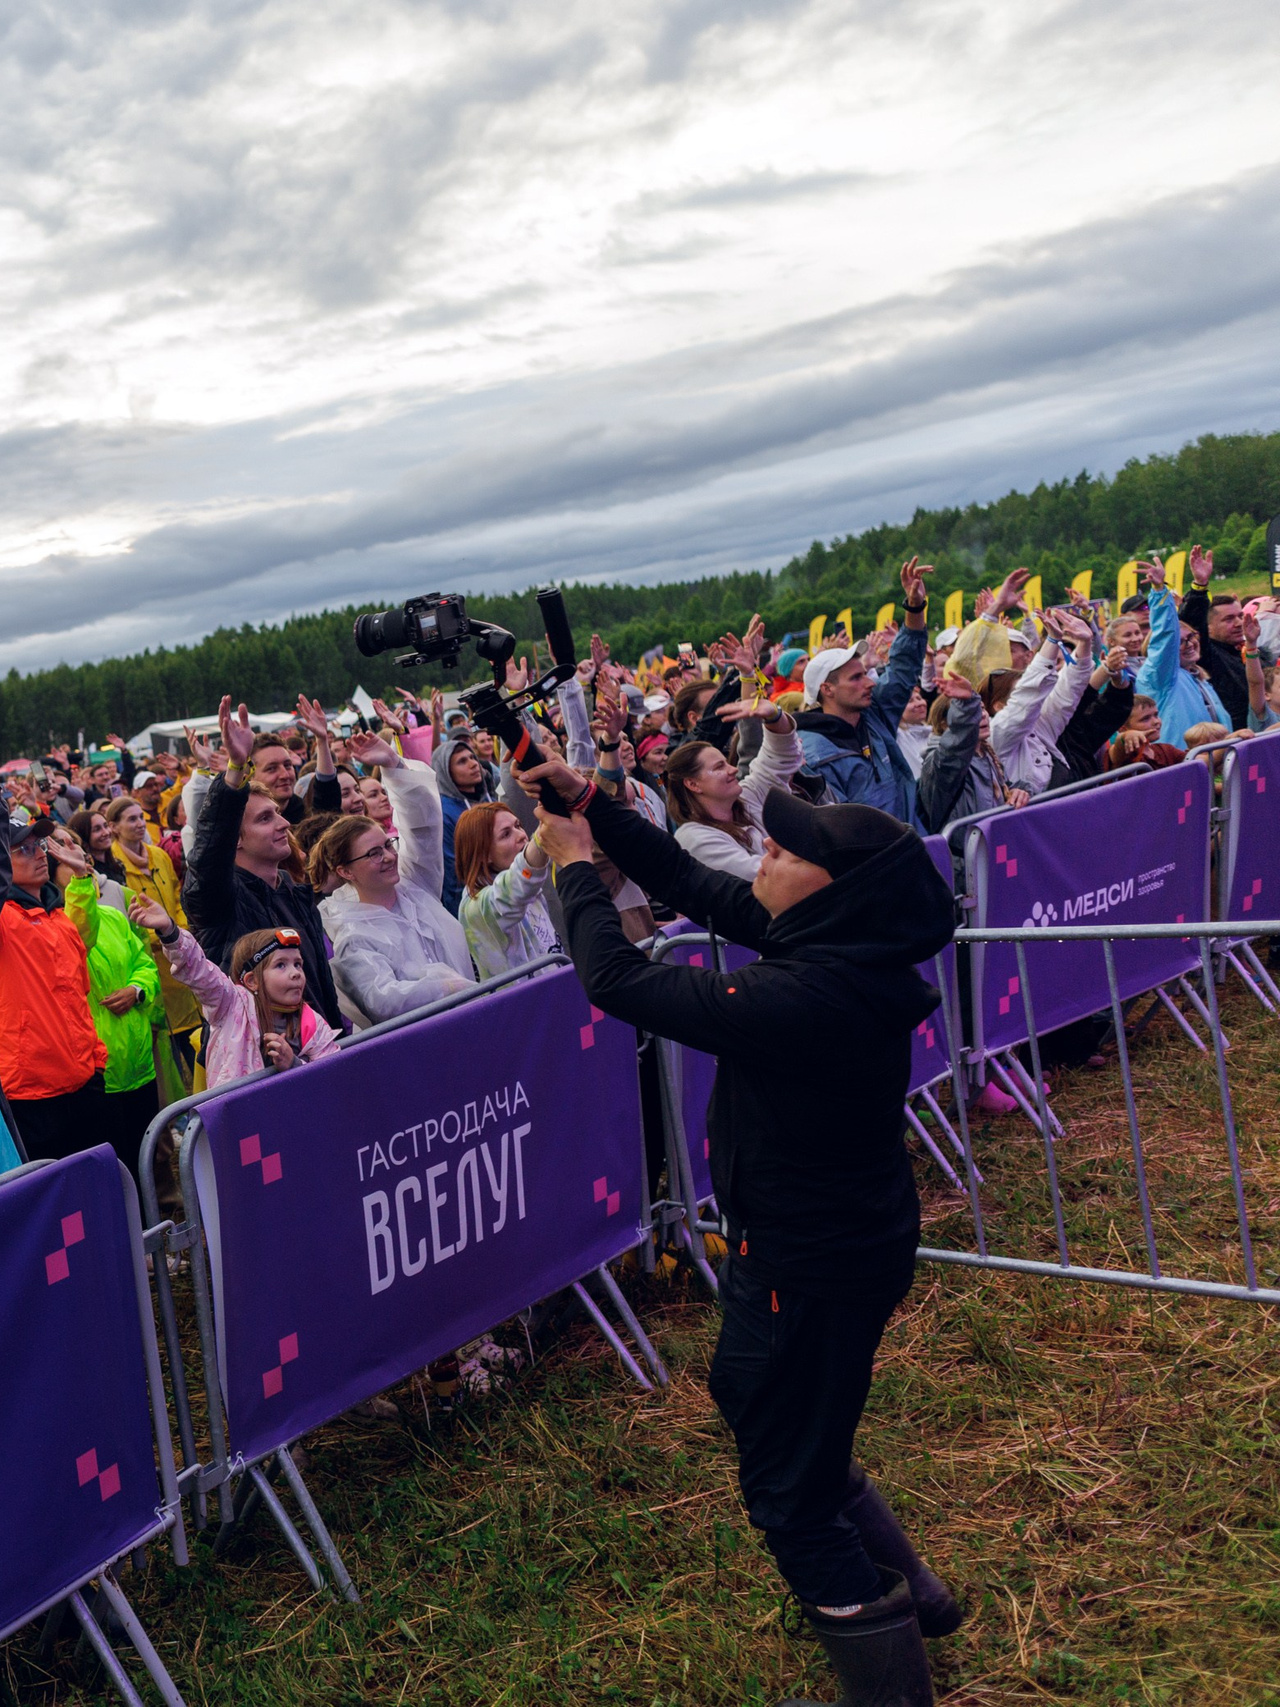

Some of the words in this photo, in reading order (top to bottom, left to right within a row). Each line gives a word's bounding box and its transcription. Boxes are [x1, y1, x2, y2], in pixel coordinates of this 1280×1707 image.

[1137, 862, 1176, 884] пространство
[1137, 879, 1164, 896] здоровья
[1063, 878, 1134, 922] МЕДСИ
[357, 1081, 531, 1181] ГАСТРОДАЧА
[362, 1122, 531, 1295] ВСЕЛУГ
